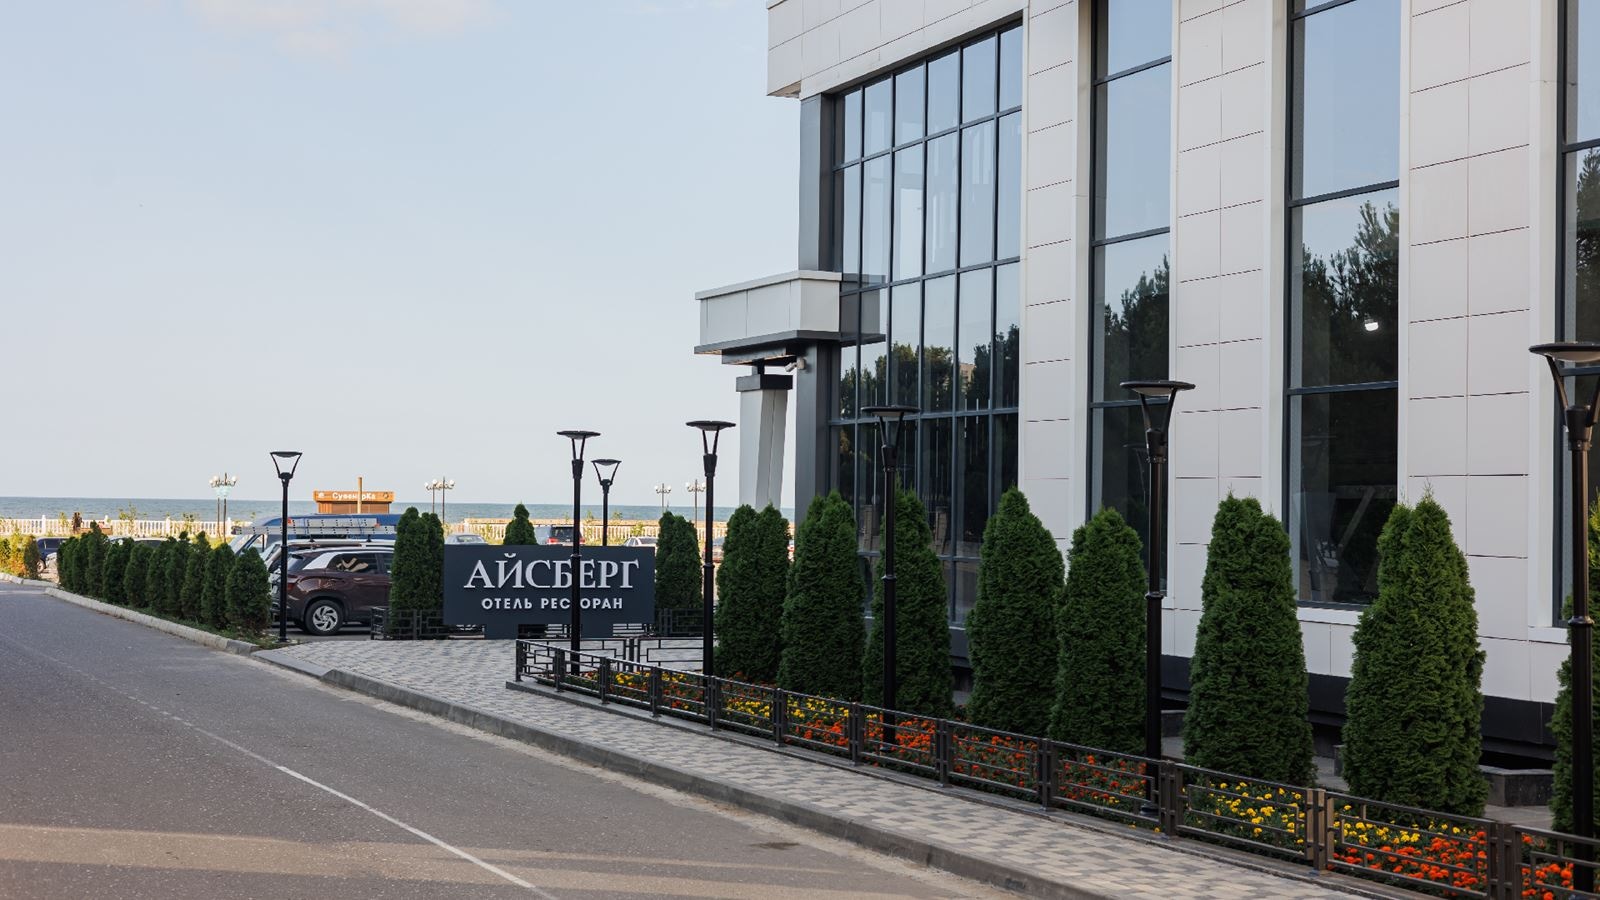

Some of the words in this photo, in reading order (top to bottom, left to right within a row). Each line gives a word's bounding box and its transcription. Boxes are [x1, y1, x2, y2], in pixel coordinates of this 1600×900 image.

[464, 553, 640, 589] АЙСБЕРГ
[481, 597, 533, 610] ОТЕЛЬ
[541, 597, 623, 610] РЕСОРАН
